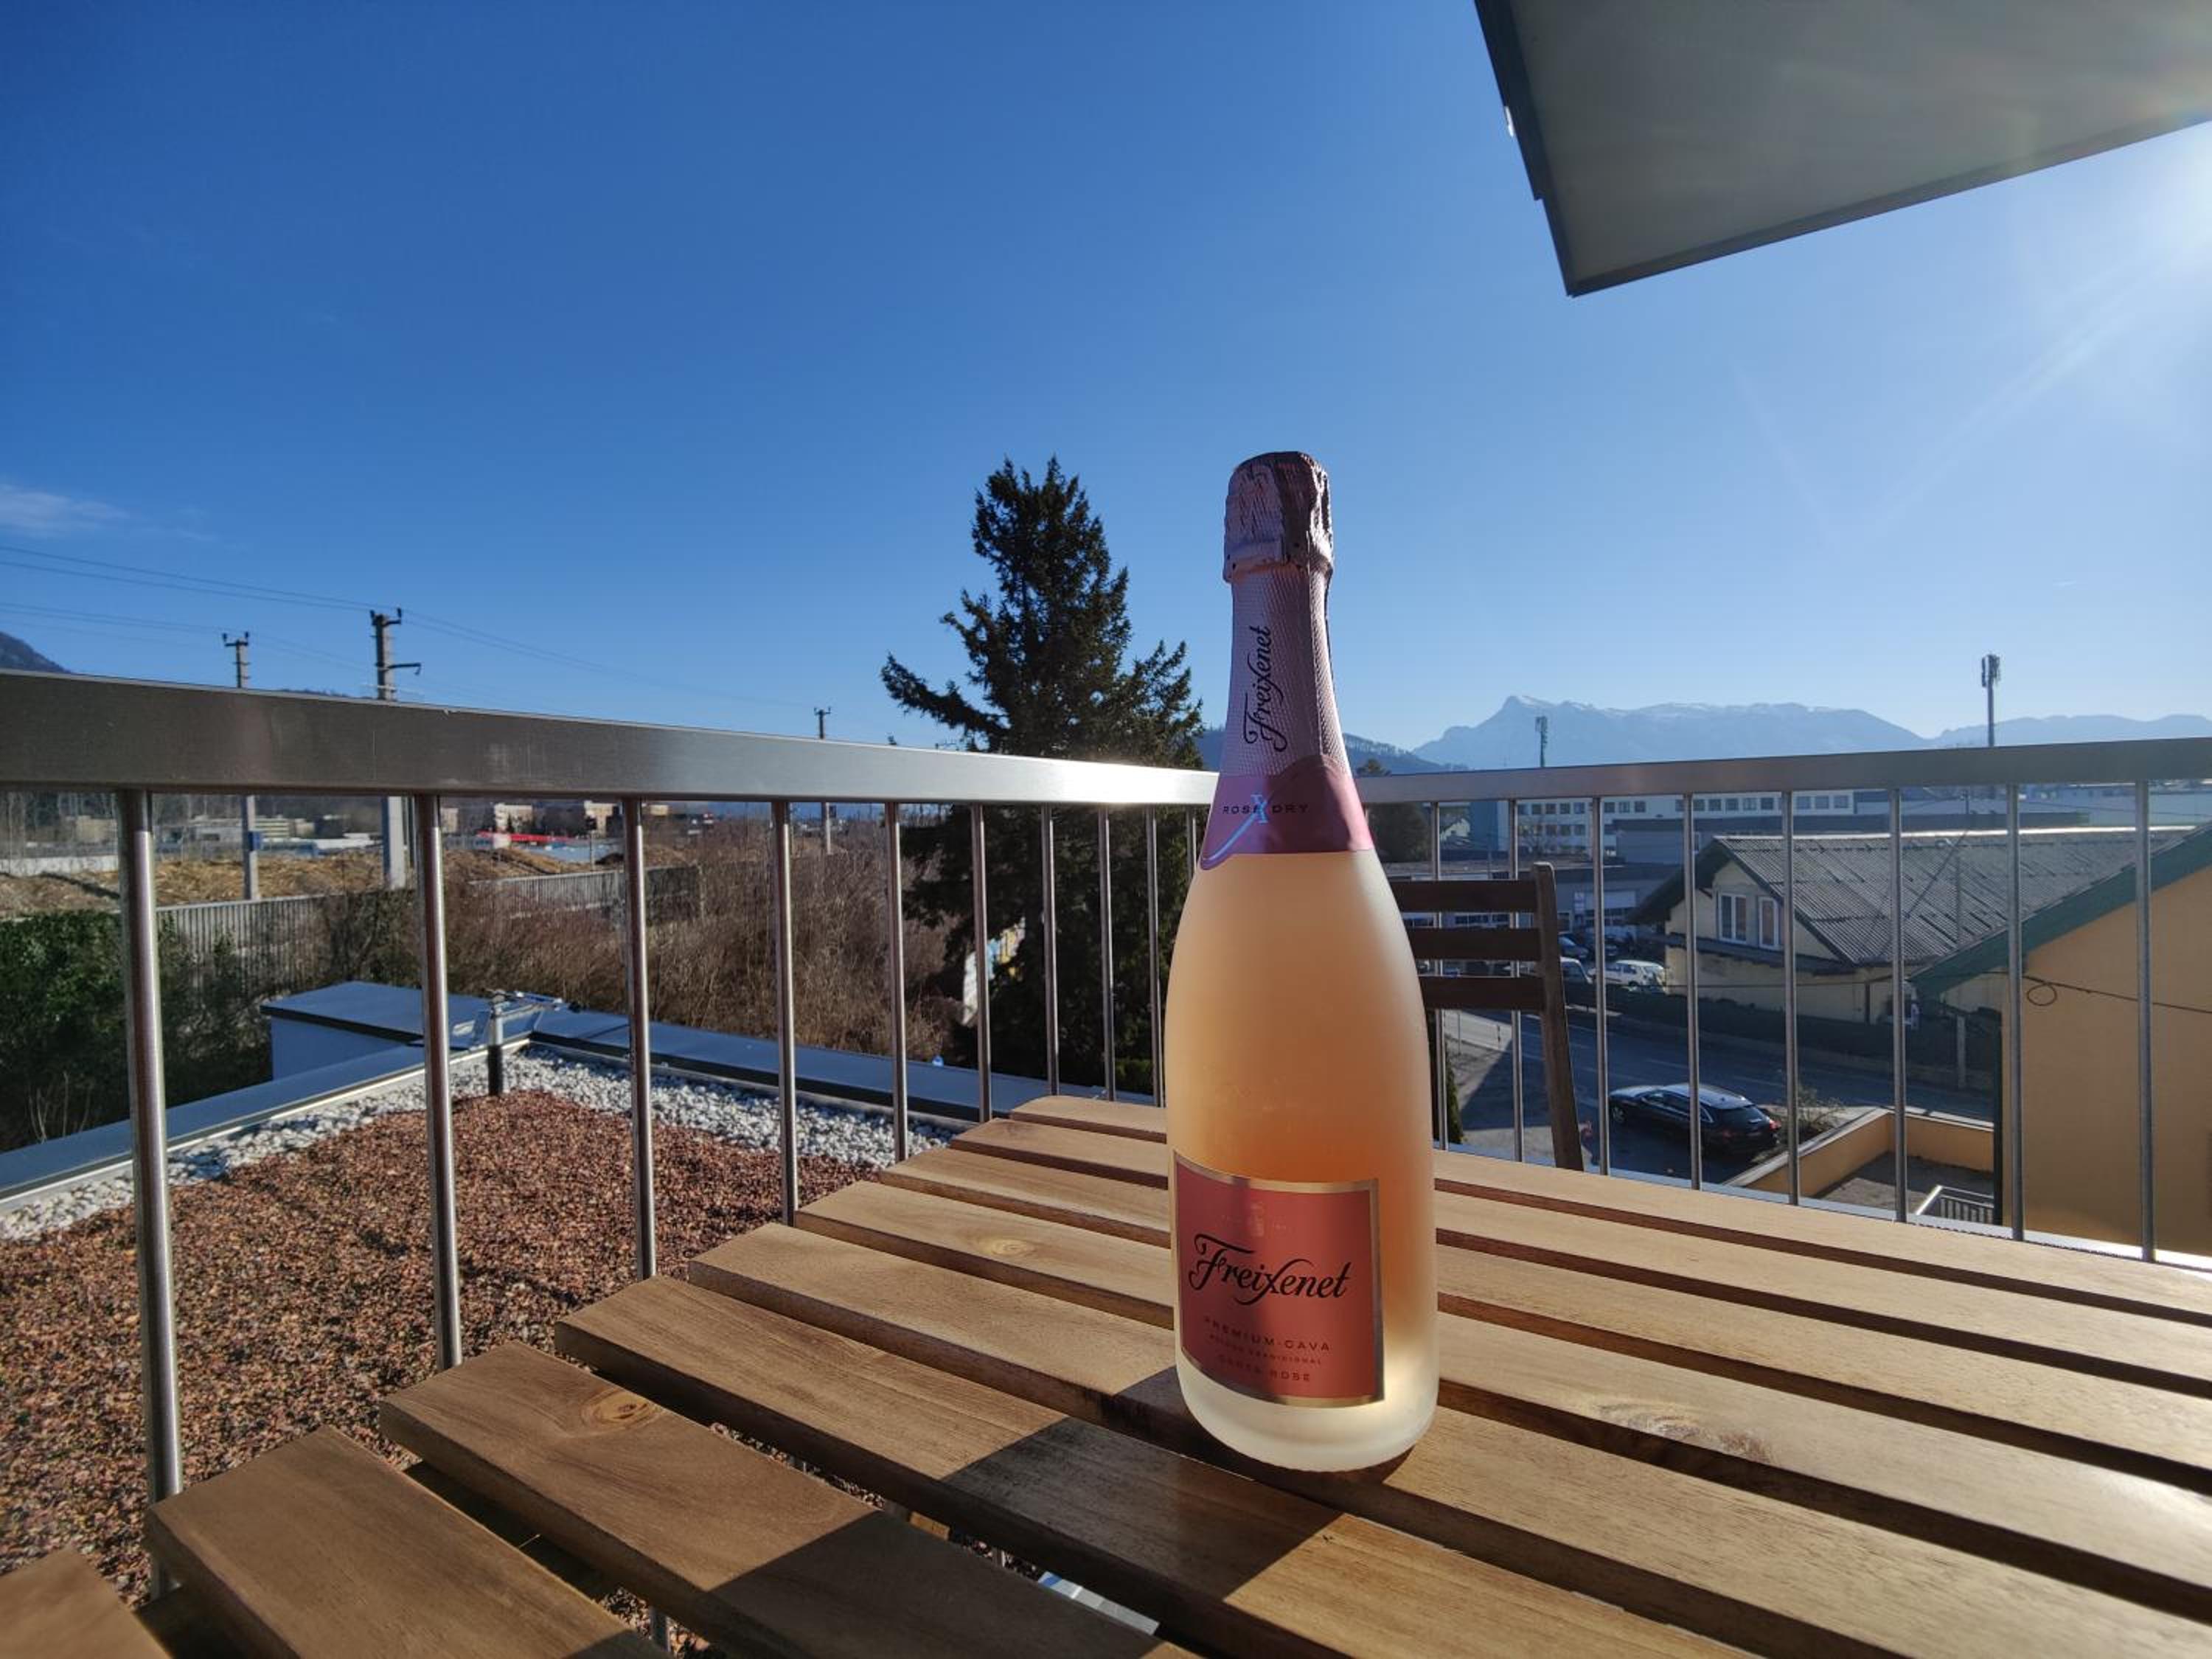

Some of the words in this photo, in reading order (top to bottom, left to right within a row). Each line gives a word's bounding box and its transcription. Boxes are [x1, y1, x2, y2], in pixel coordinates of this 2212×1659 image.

[1244, 625, 1287, 752] Freixenet
[1188, 1233, 1352, 1305] Freixenet
[1284, 1340, 1330, 1351] CAVA
